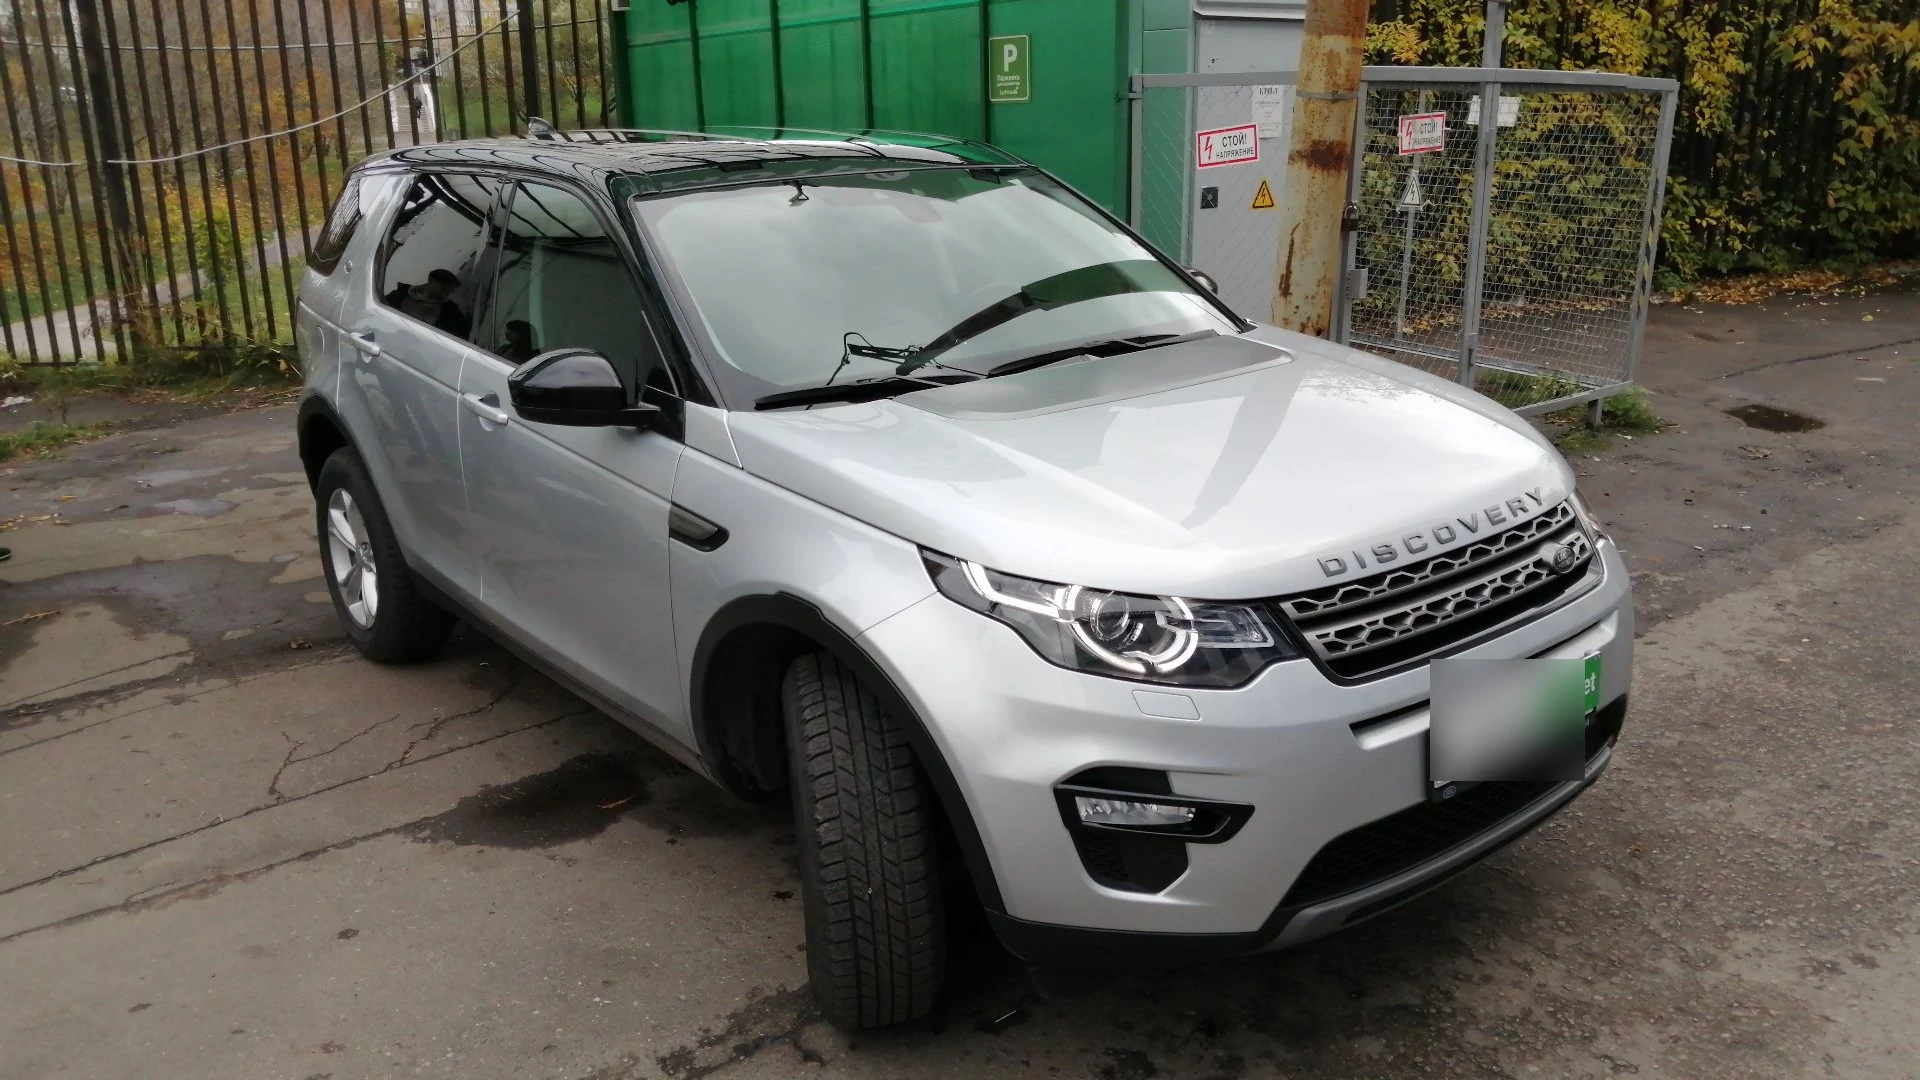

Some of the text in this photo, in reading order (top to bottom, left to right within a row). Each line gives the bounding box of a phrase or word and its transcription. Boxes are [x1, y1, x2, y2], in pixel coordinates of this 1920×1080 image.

[1003, 44, 1018, 72] P
[1420, 122, 1438, 135] СТОЙ!
[1222, 132, 1247, 148] СТОЙ!
[1215, 147, 1255, 159] НАПРЯЖЕНИЕ
[1317, 487, 1544, 577] DISCOVERY
